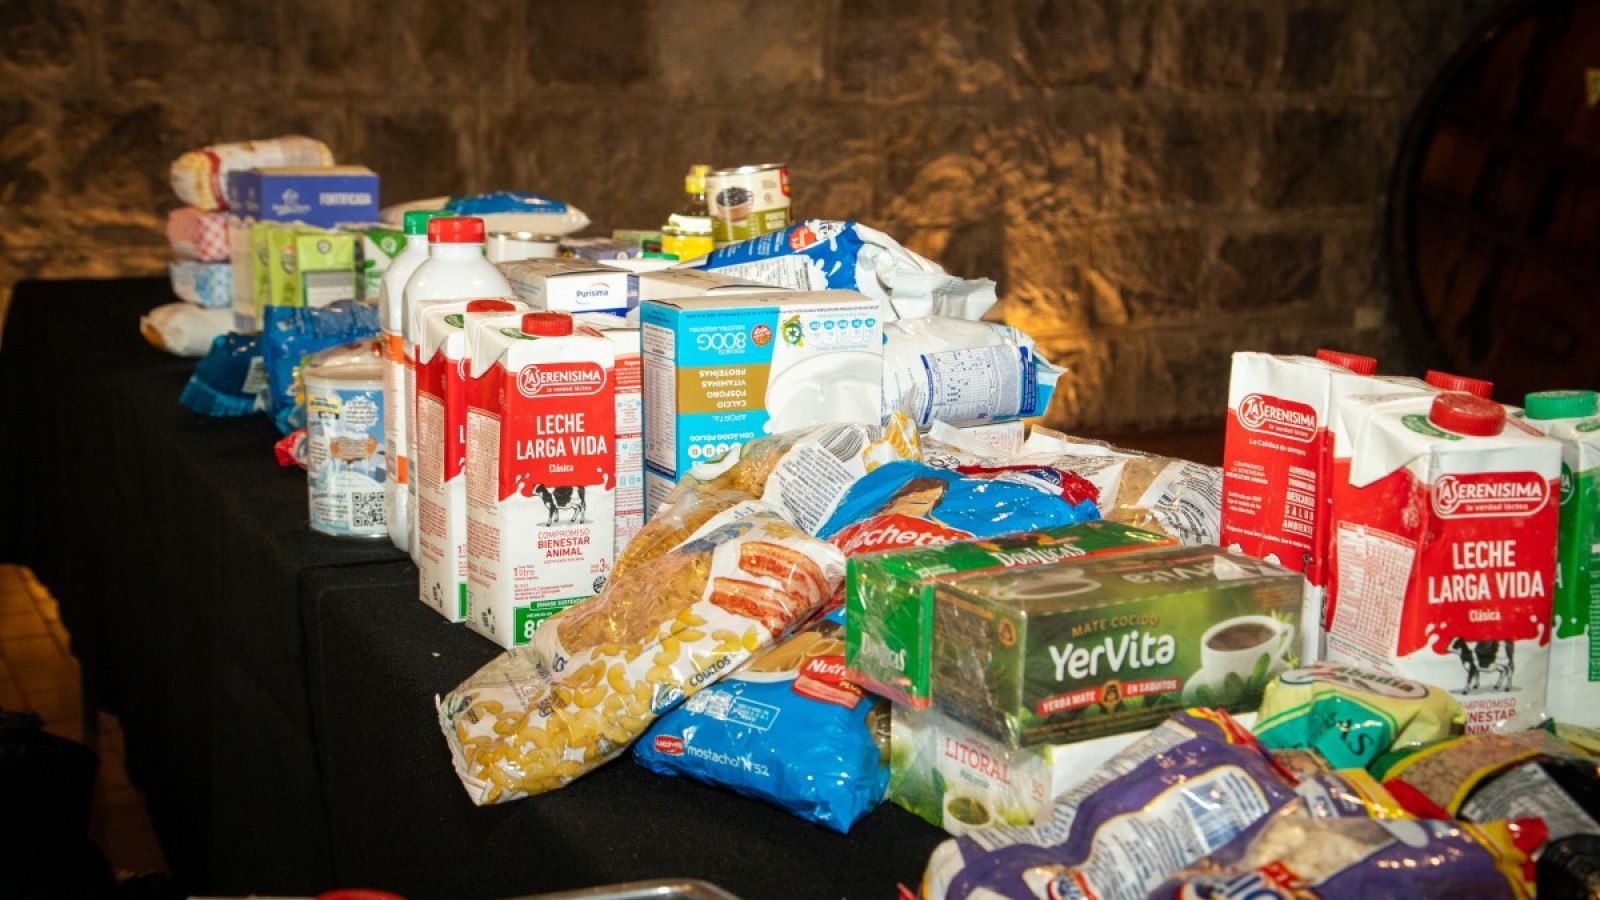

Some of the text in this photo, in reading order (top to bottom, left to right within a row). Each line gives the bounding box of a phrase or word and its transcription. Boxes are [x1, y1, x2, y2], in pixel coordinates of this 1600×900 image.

[696, 332, 746, 351] 800G
[701, 379, 746, 388] VITAMINAS
[717, 400, 746, 409] CALCIO
[536, 413, 585, 435] LECHE
[516, 435, 608, 460] LARGA VIDA
[1258, 439, 1279, 450] Calidad
[549, 463, 574, 473] Clásica
[537, 536, 590, 549] BIENESTAR
[538, 527, 590, 539] COMPROMISO
[545, 549, 583, 558] ANIMAL
[1452, 540, 1516, 570] LECHE
[1428, 570, 1545, 604] LARGA VIDA
[1469, 609, 1502, 622] Clásica
[1071, 613, 1160, 638] MATE COCIDO
[1048, 630, 1176, 682] YerVita
[1127, 680, 1177, 695] EN SAQUITOS
[1042, 690, 1096, 713] YERBA MATE
[687, 746, 741, 769] mostachol
[945, 737, 1011, 785] LITORAL
